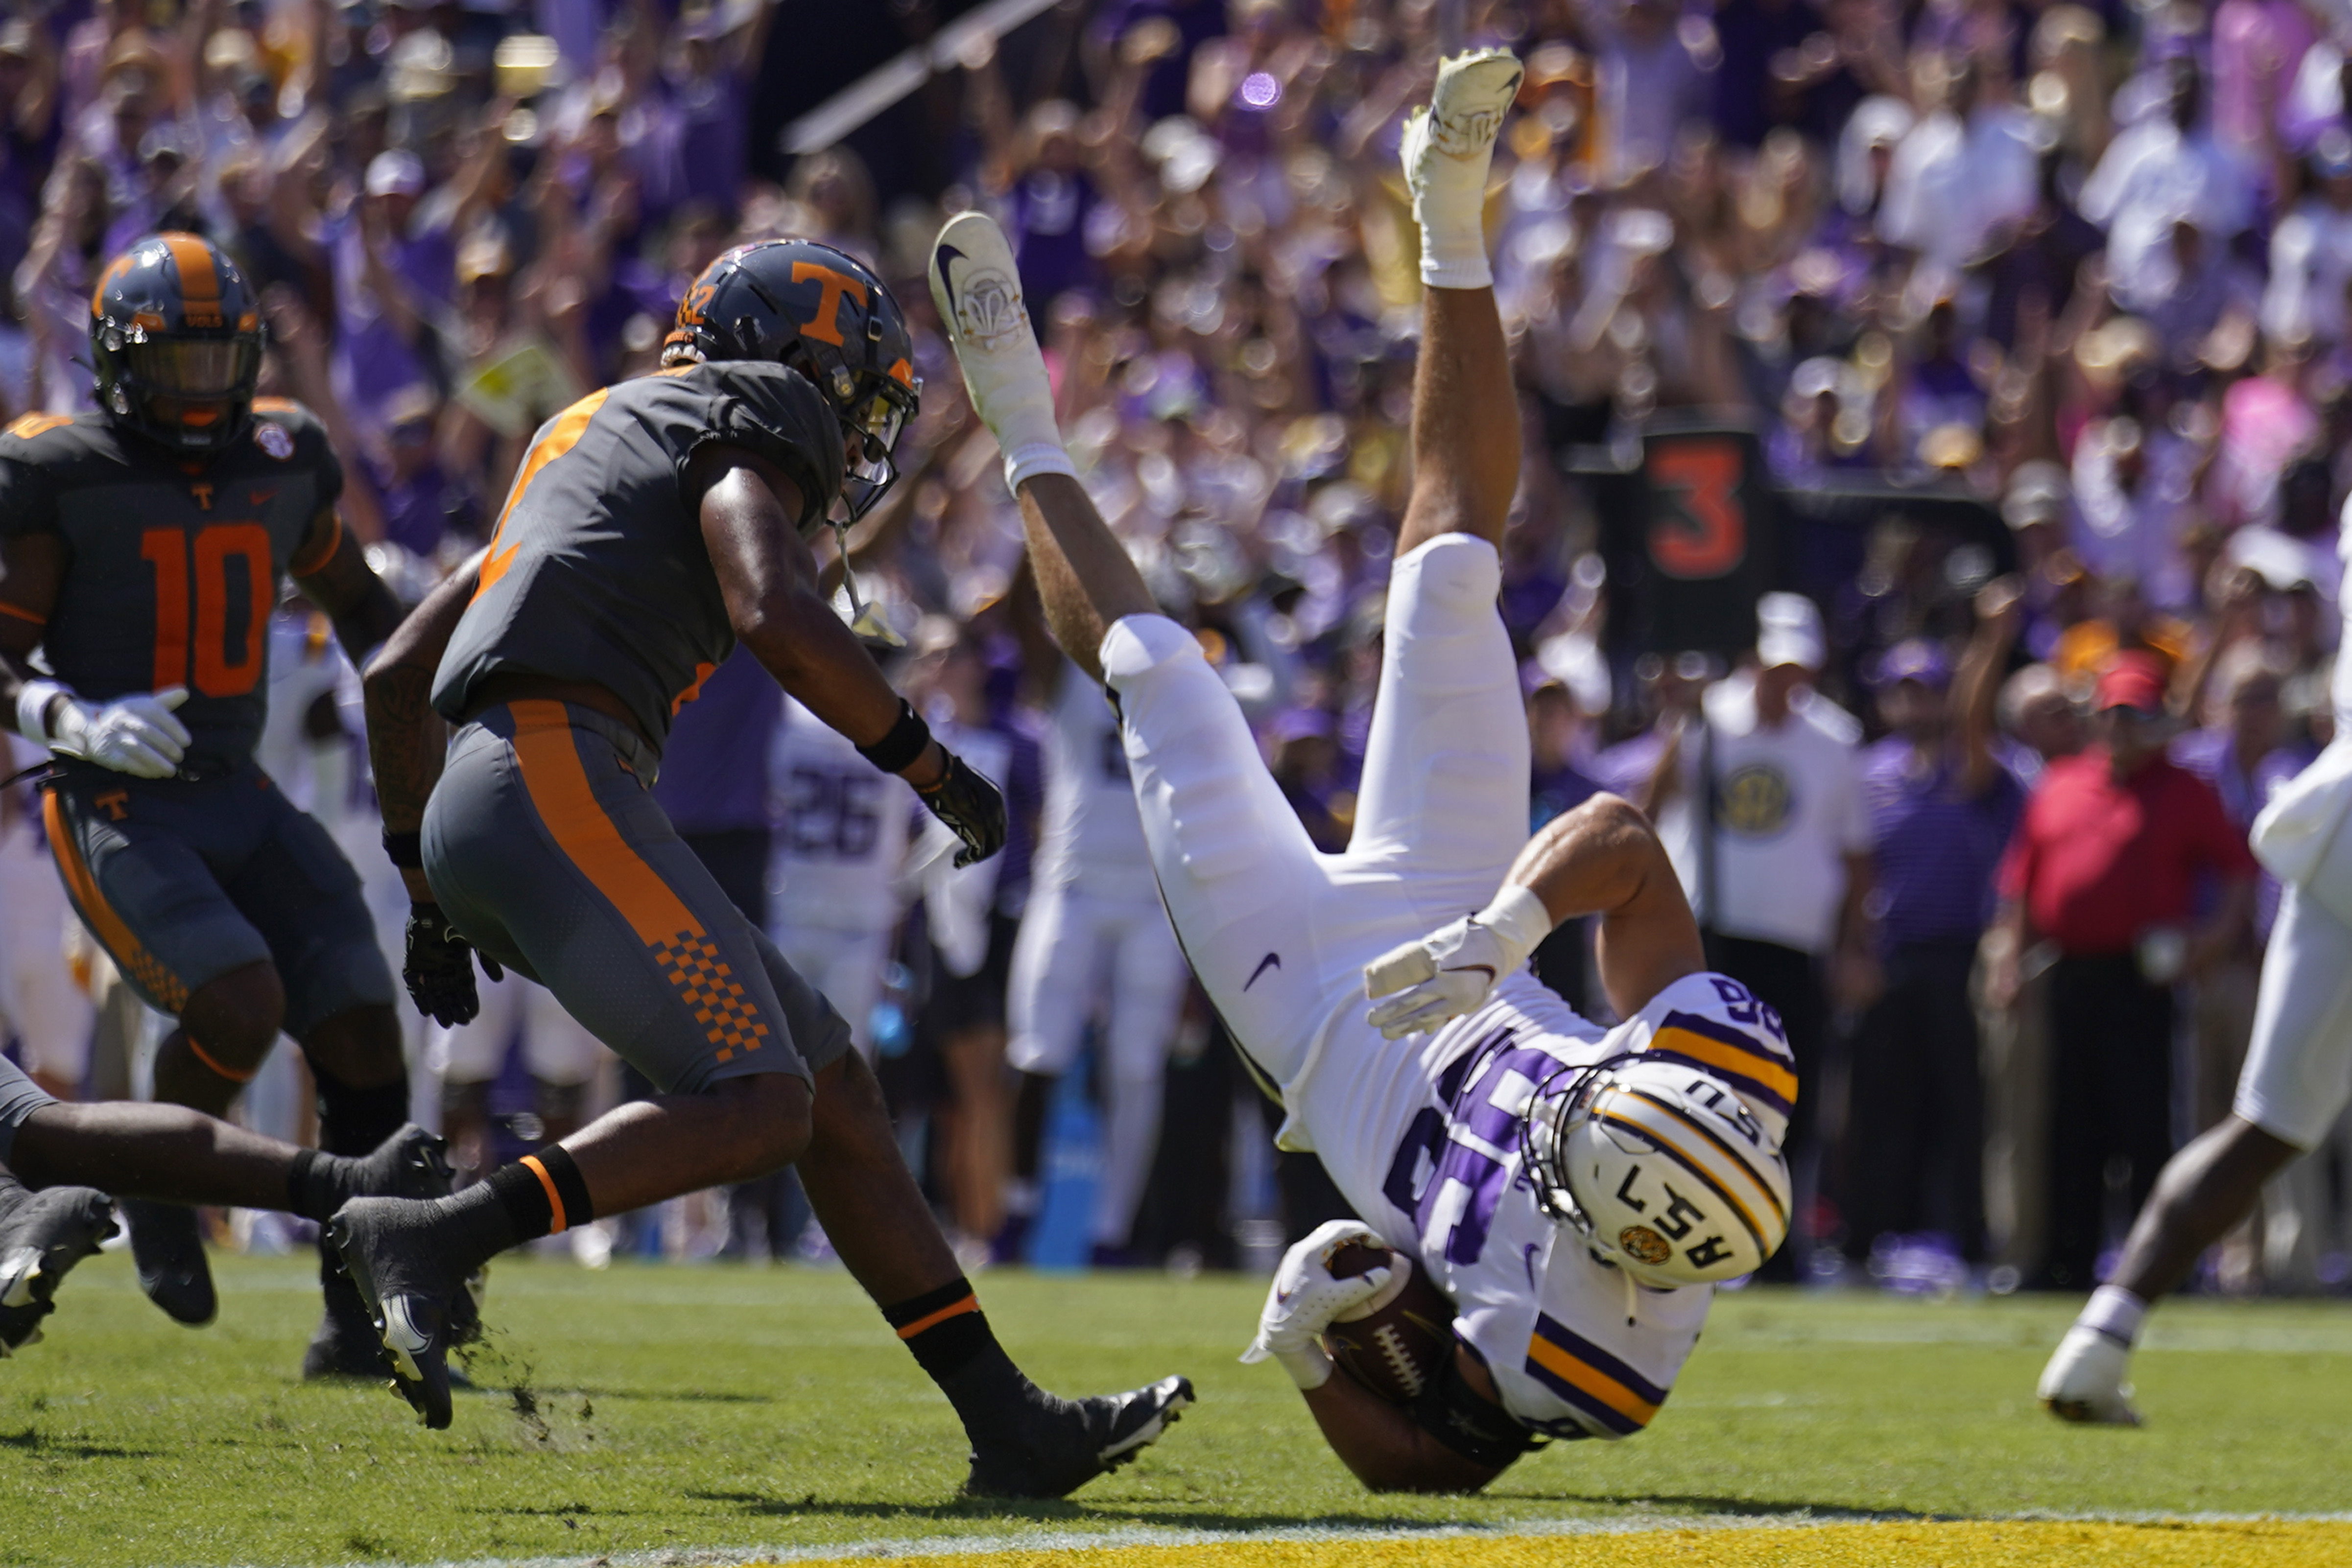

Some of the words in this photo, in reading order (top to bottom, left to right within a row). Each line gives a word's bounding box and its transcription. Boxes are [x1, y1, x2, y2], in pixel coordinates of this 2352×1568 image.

[691, 284, 715, 325] 2
[791, 261, 868, 347] T
[191, 483, 214, 510] T
[1647, 435, 1744, 579] 3
[141, 521, 275, 698] 10
[95, 788, 128, 820] T
[1616, 1165, 1735, 1269] LSU
